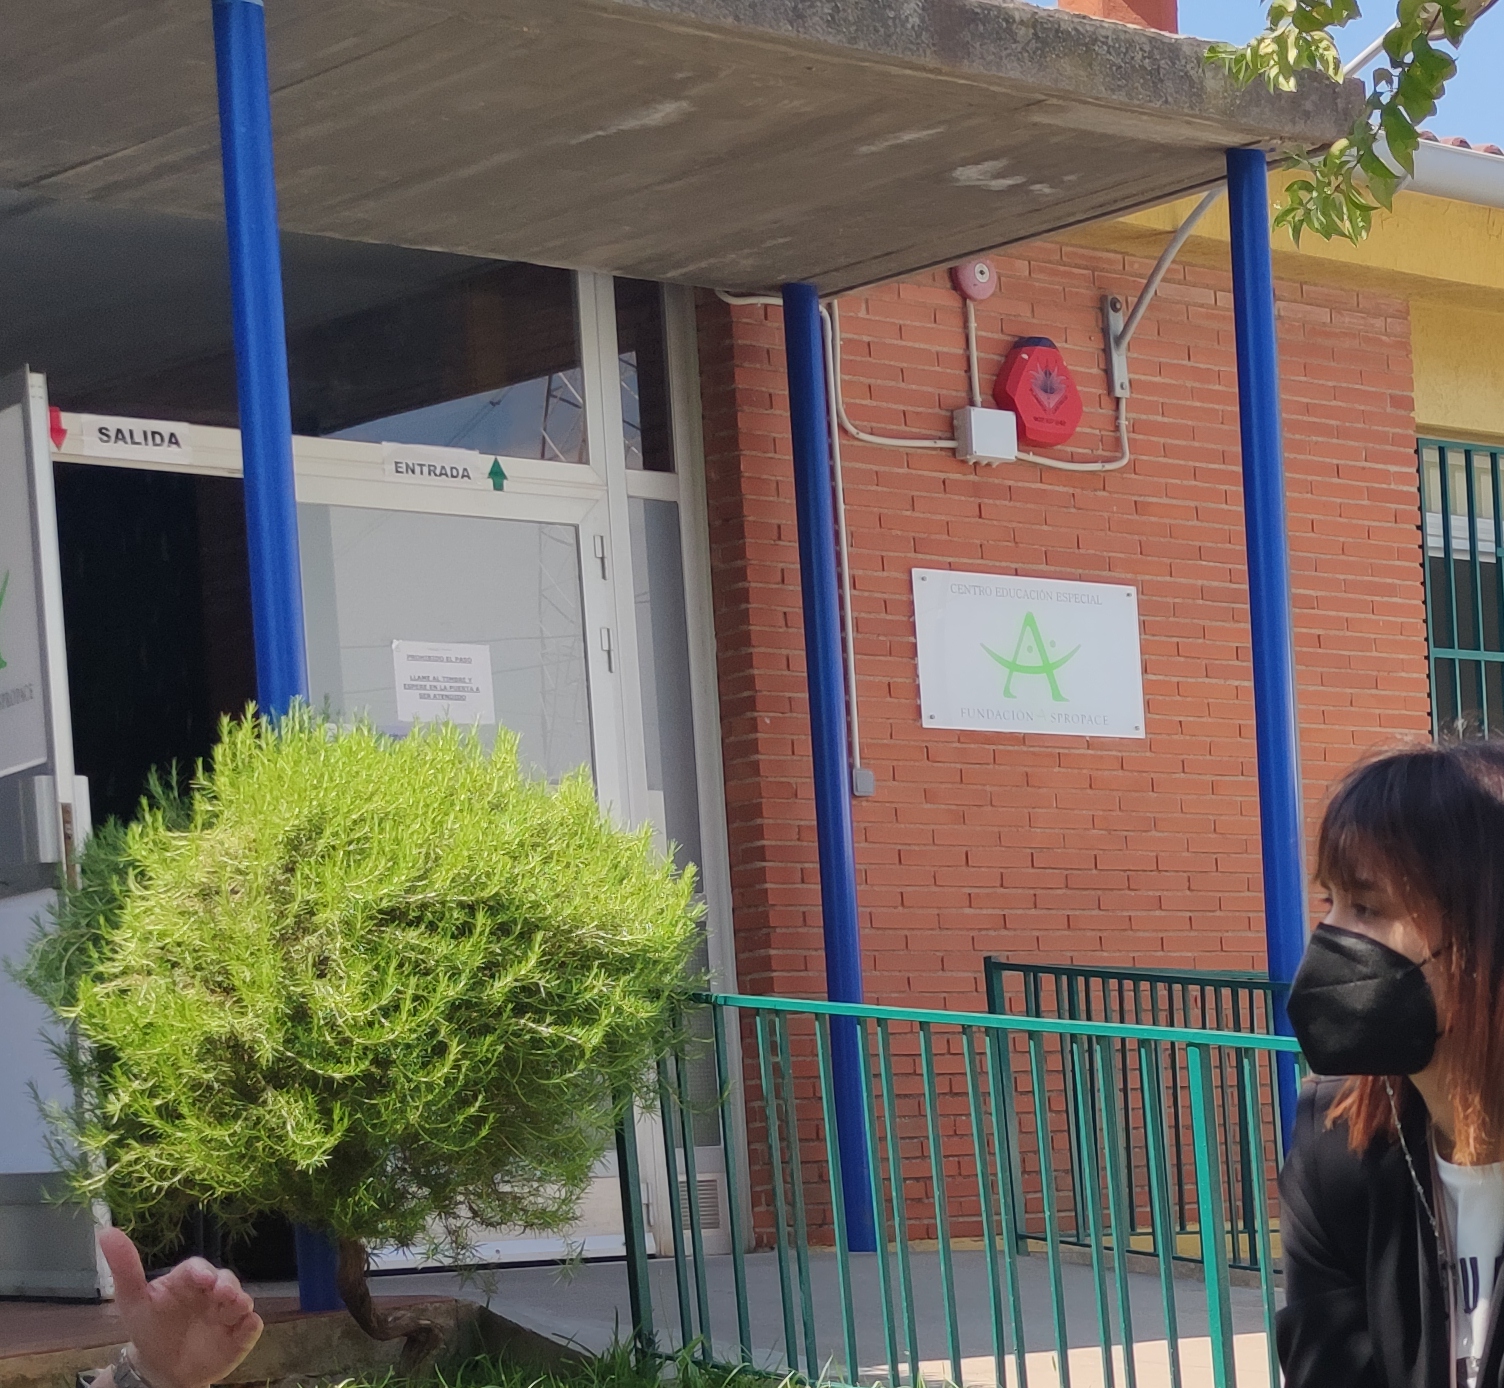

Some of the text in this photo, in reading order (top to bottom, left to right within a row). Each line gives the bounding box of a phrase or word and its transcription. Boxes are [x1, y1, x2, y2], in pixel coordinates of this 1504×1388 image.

[97, 425, 182, 450] SALIDA
[394, 460, 472, 481] ENTRADA
[950, 583, 1103, 606] CENTRO EDUCACIÓN ESPECIAL
[406, 654, 444, 663] PROHIBIDO
[455, 656, 472, 664] PASO
[403, 683, 427, 691] ESPERE
[449, 685, 474, 693] PUERTA
[960, 707, 1034, 722] FUNDACIÓN
